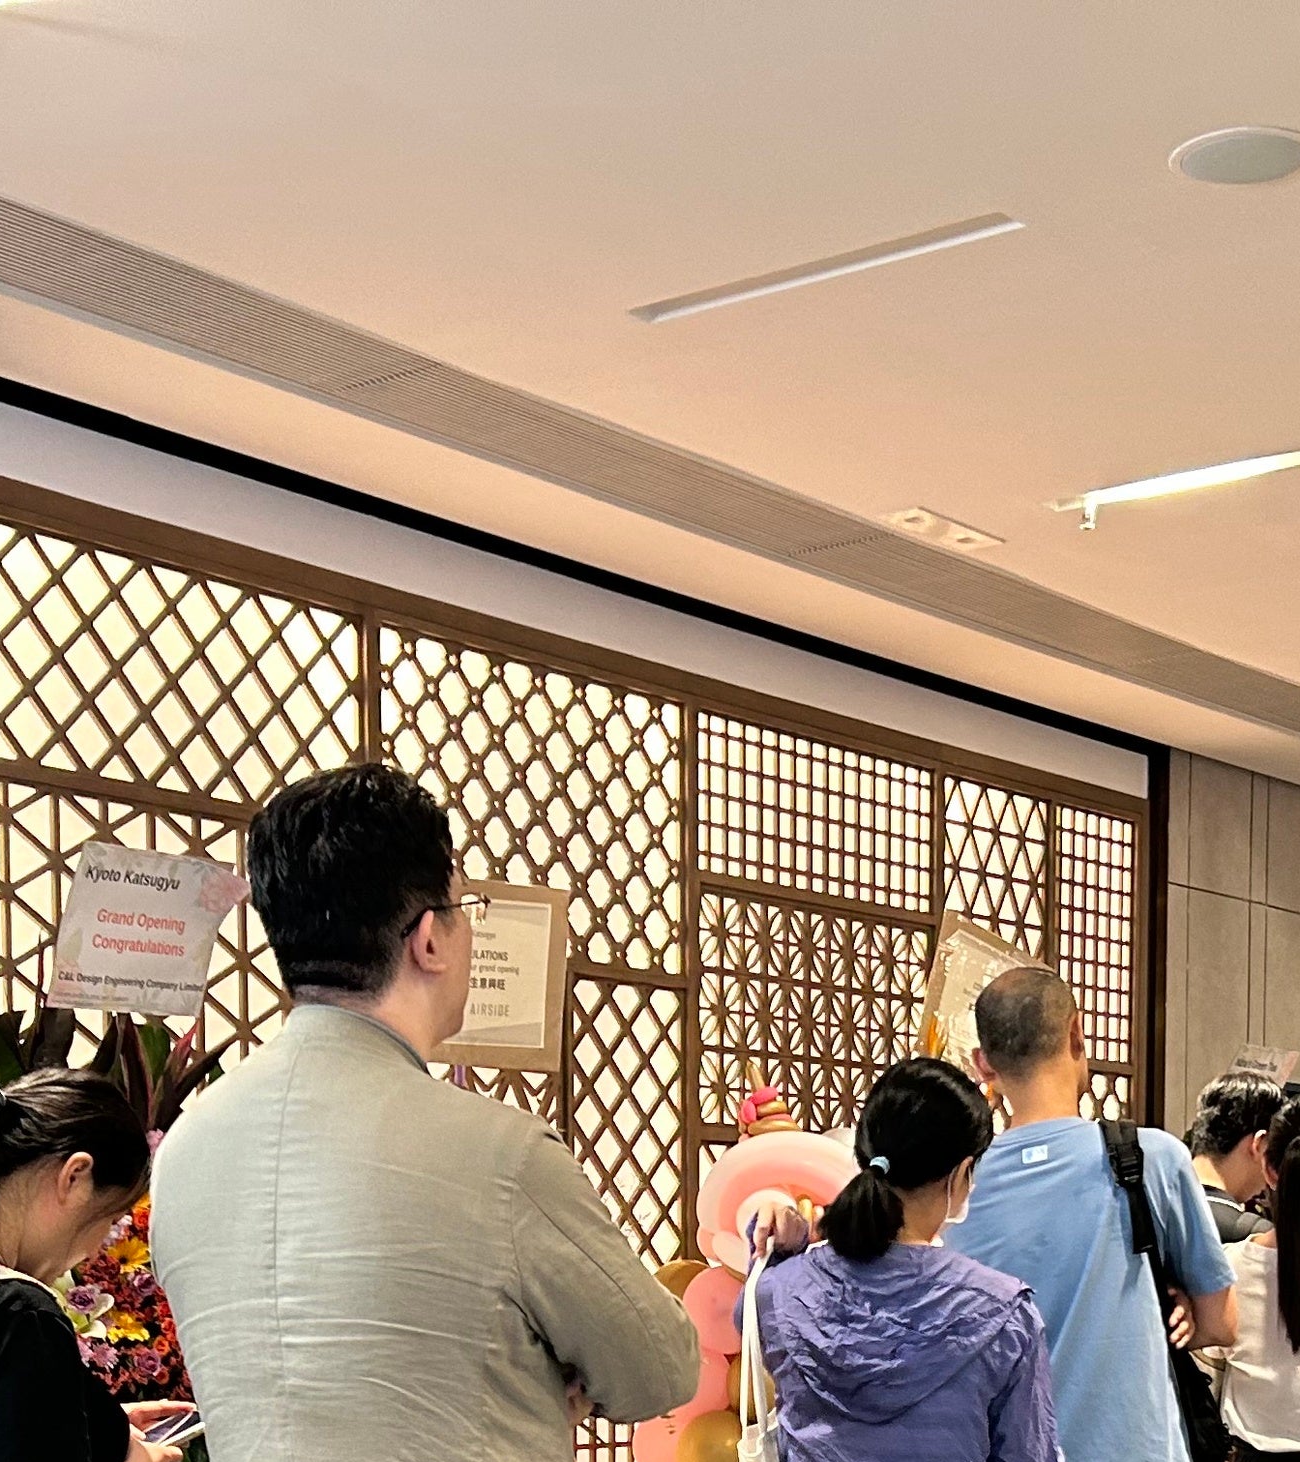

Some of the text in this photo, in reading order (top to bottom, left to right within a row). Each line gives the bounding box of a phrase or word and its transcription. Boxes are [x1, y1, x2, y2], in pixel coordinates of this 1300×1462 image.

[85, 865, 181, 892] Kyoto Katsugyu
[97, 908, 186, 936] Grand Opening
[92, 933, 185, 957] Congratulations
[471, 949, 509, 961] ULATIONS
[76, 973, 102, 986] Design
[104, 976, 145, 990] Engineering
[146, 980, 178, 992] Company
[469, 1003, 510, 1017] AIRSIDE
